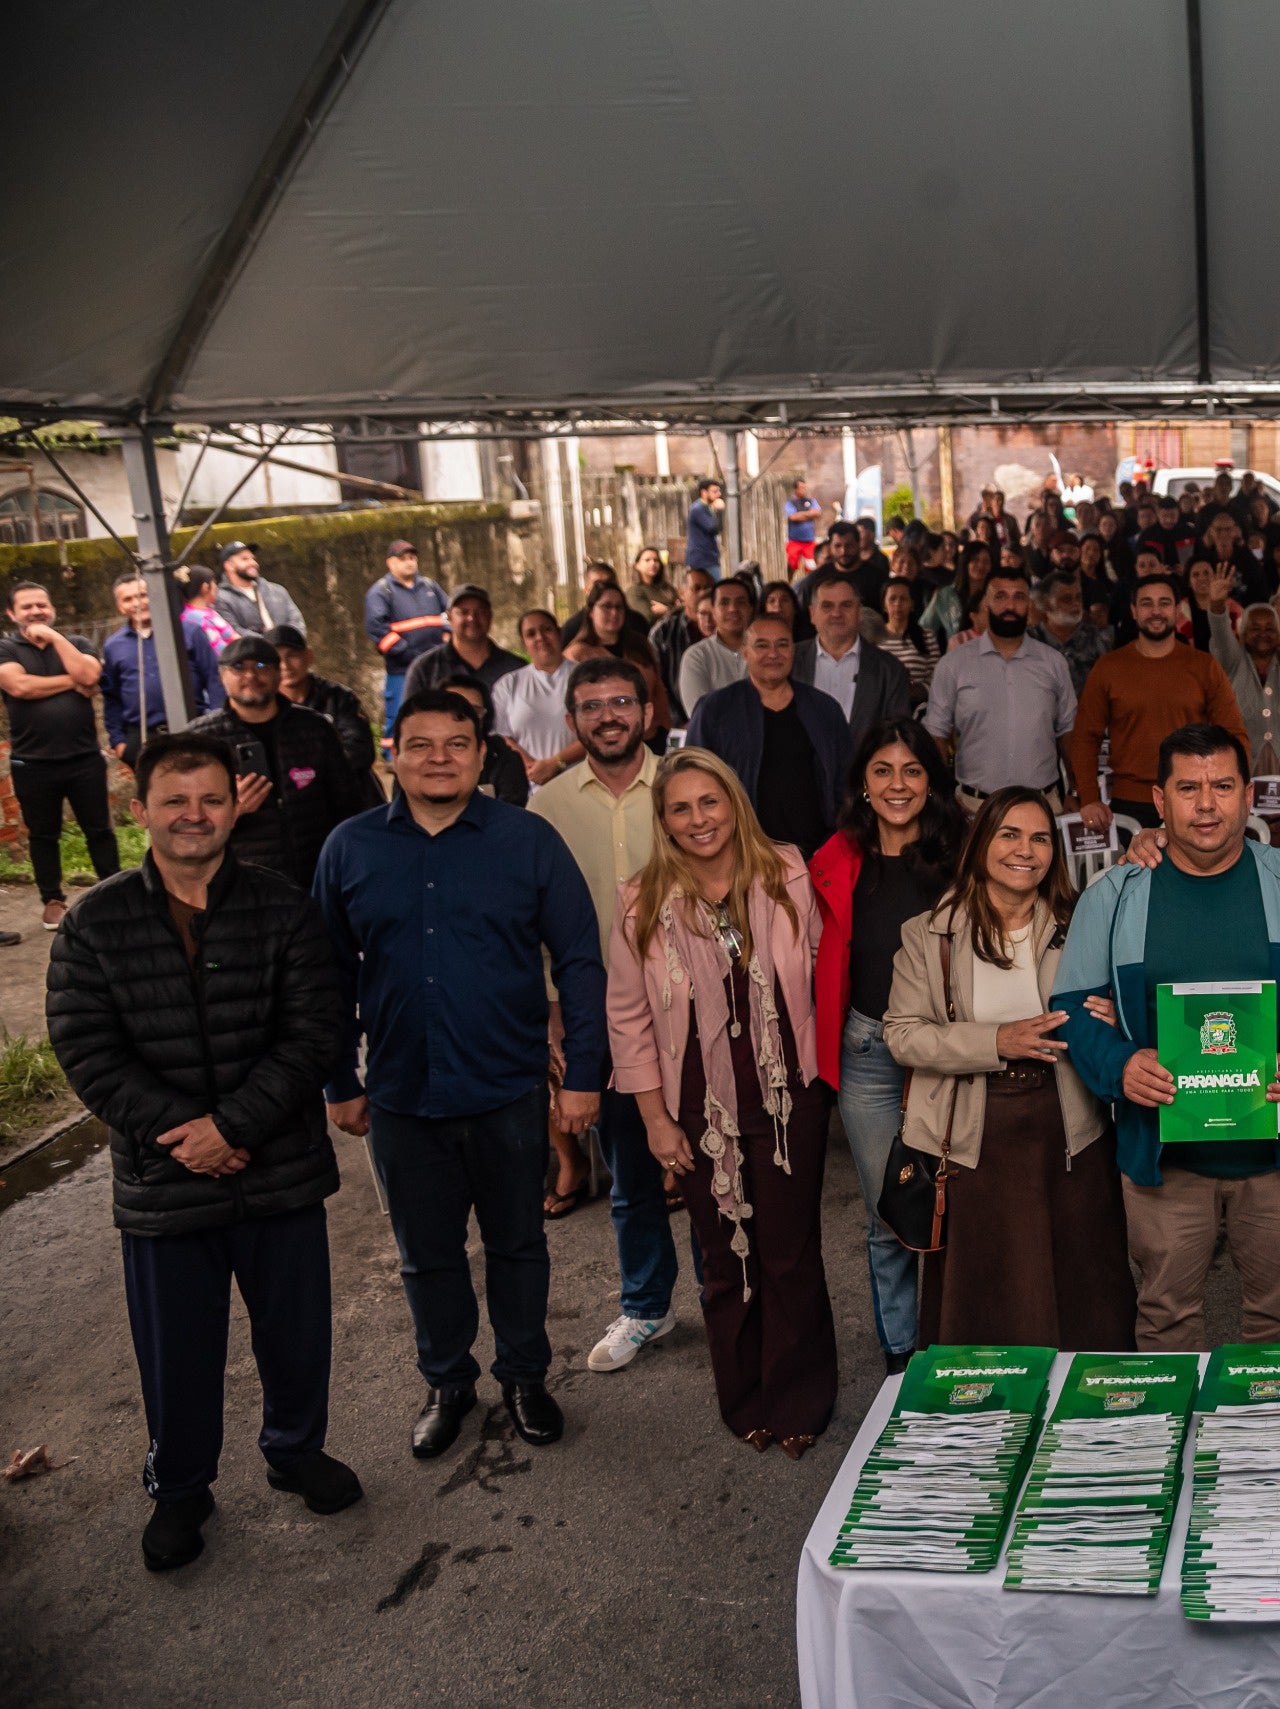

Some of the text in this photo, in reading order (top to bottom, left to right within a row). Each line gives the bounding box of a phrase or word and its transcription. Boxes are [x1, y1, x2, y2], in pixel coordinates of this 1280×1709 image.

[1177, 1069, 1261, 1089] PARANAGUÁ
[935, 1367, 1028, 1378] PARANAGUÁ
[1086, 1376, 1176, 1386] PARANAGUÁ
